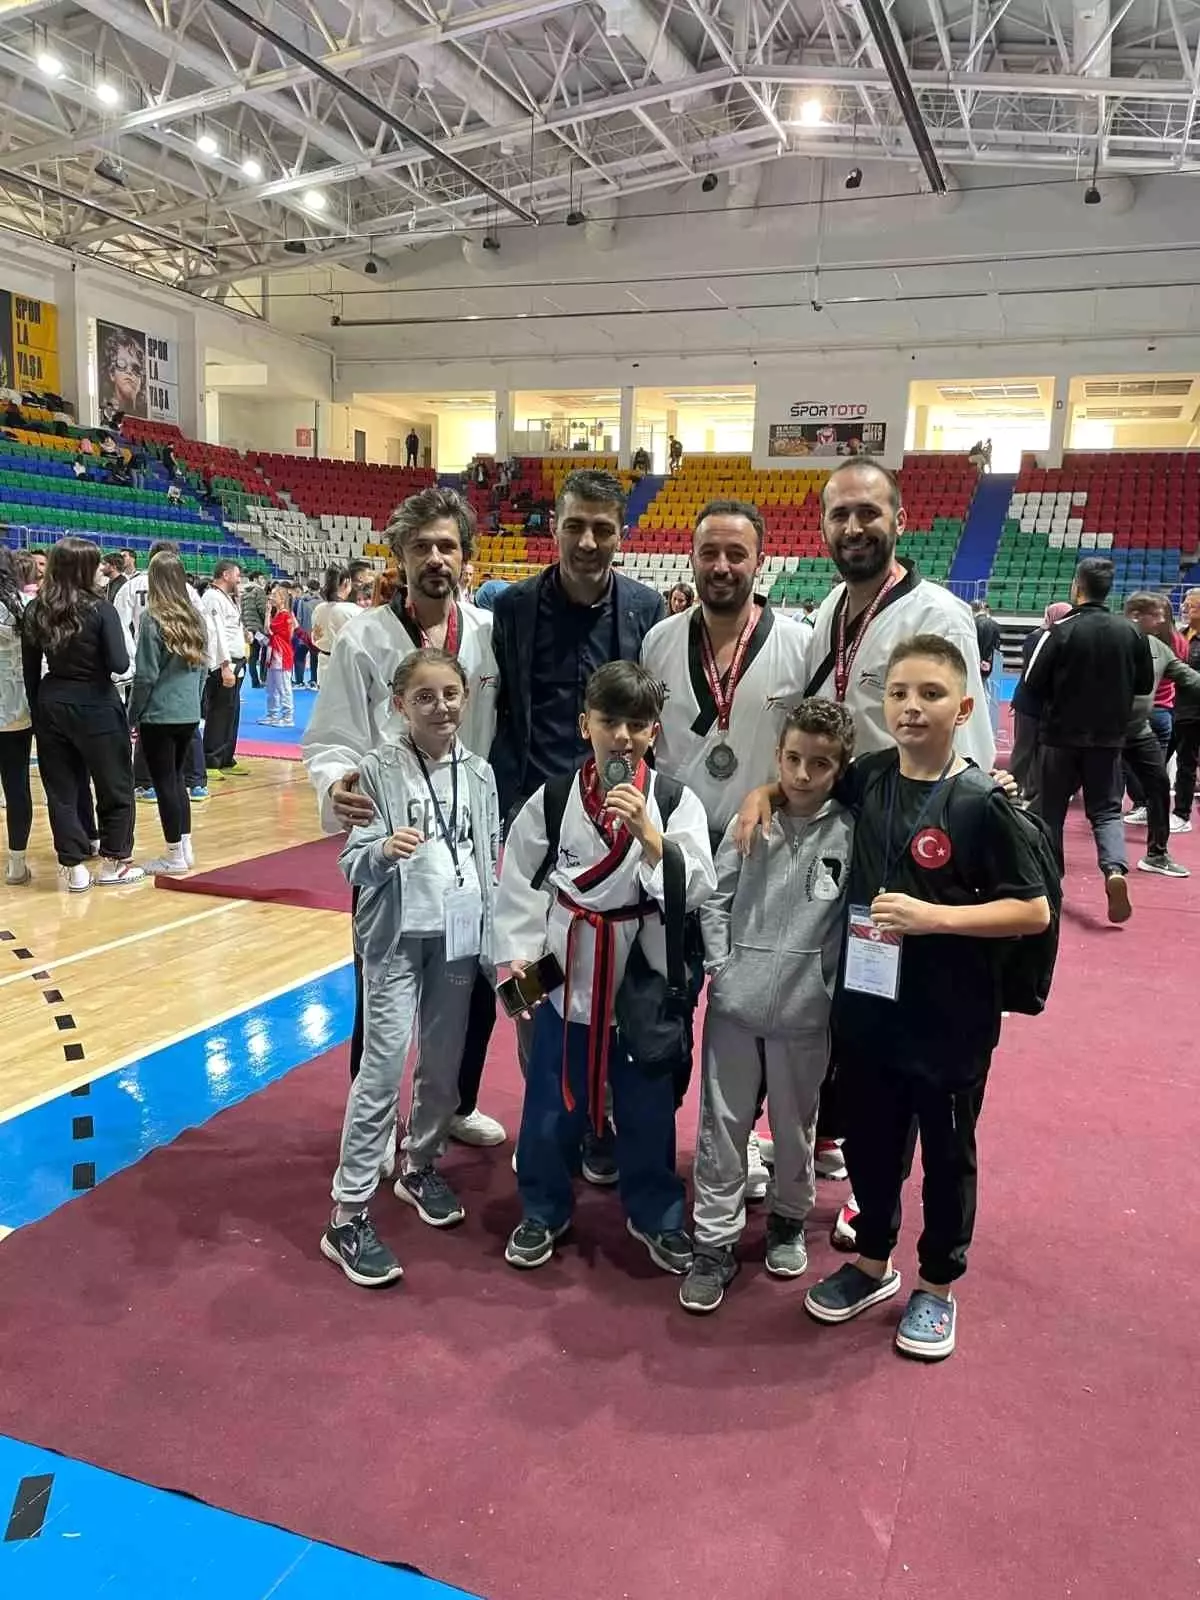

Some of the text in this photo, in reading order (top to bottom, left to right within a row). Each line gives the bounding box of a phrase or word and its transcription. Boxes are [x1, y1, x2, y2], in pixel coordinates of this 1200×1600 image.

[16, 297, 41, 324] SPOR
[17, 321, 29, 346] LA
[148, 338, 168, 361] SPOR
[149, 361, 159, 381] LA
